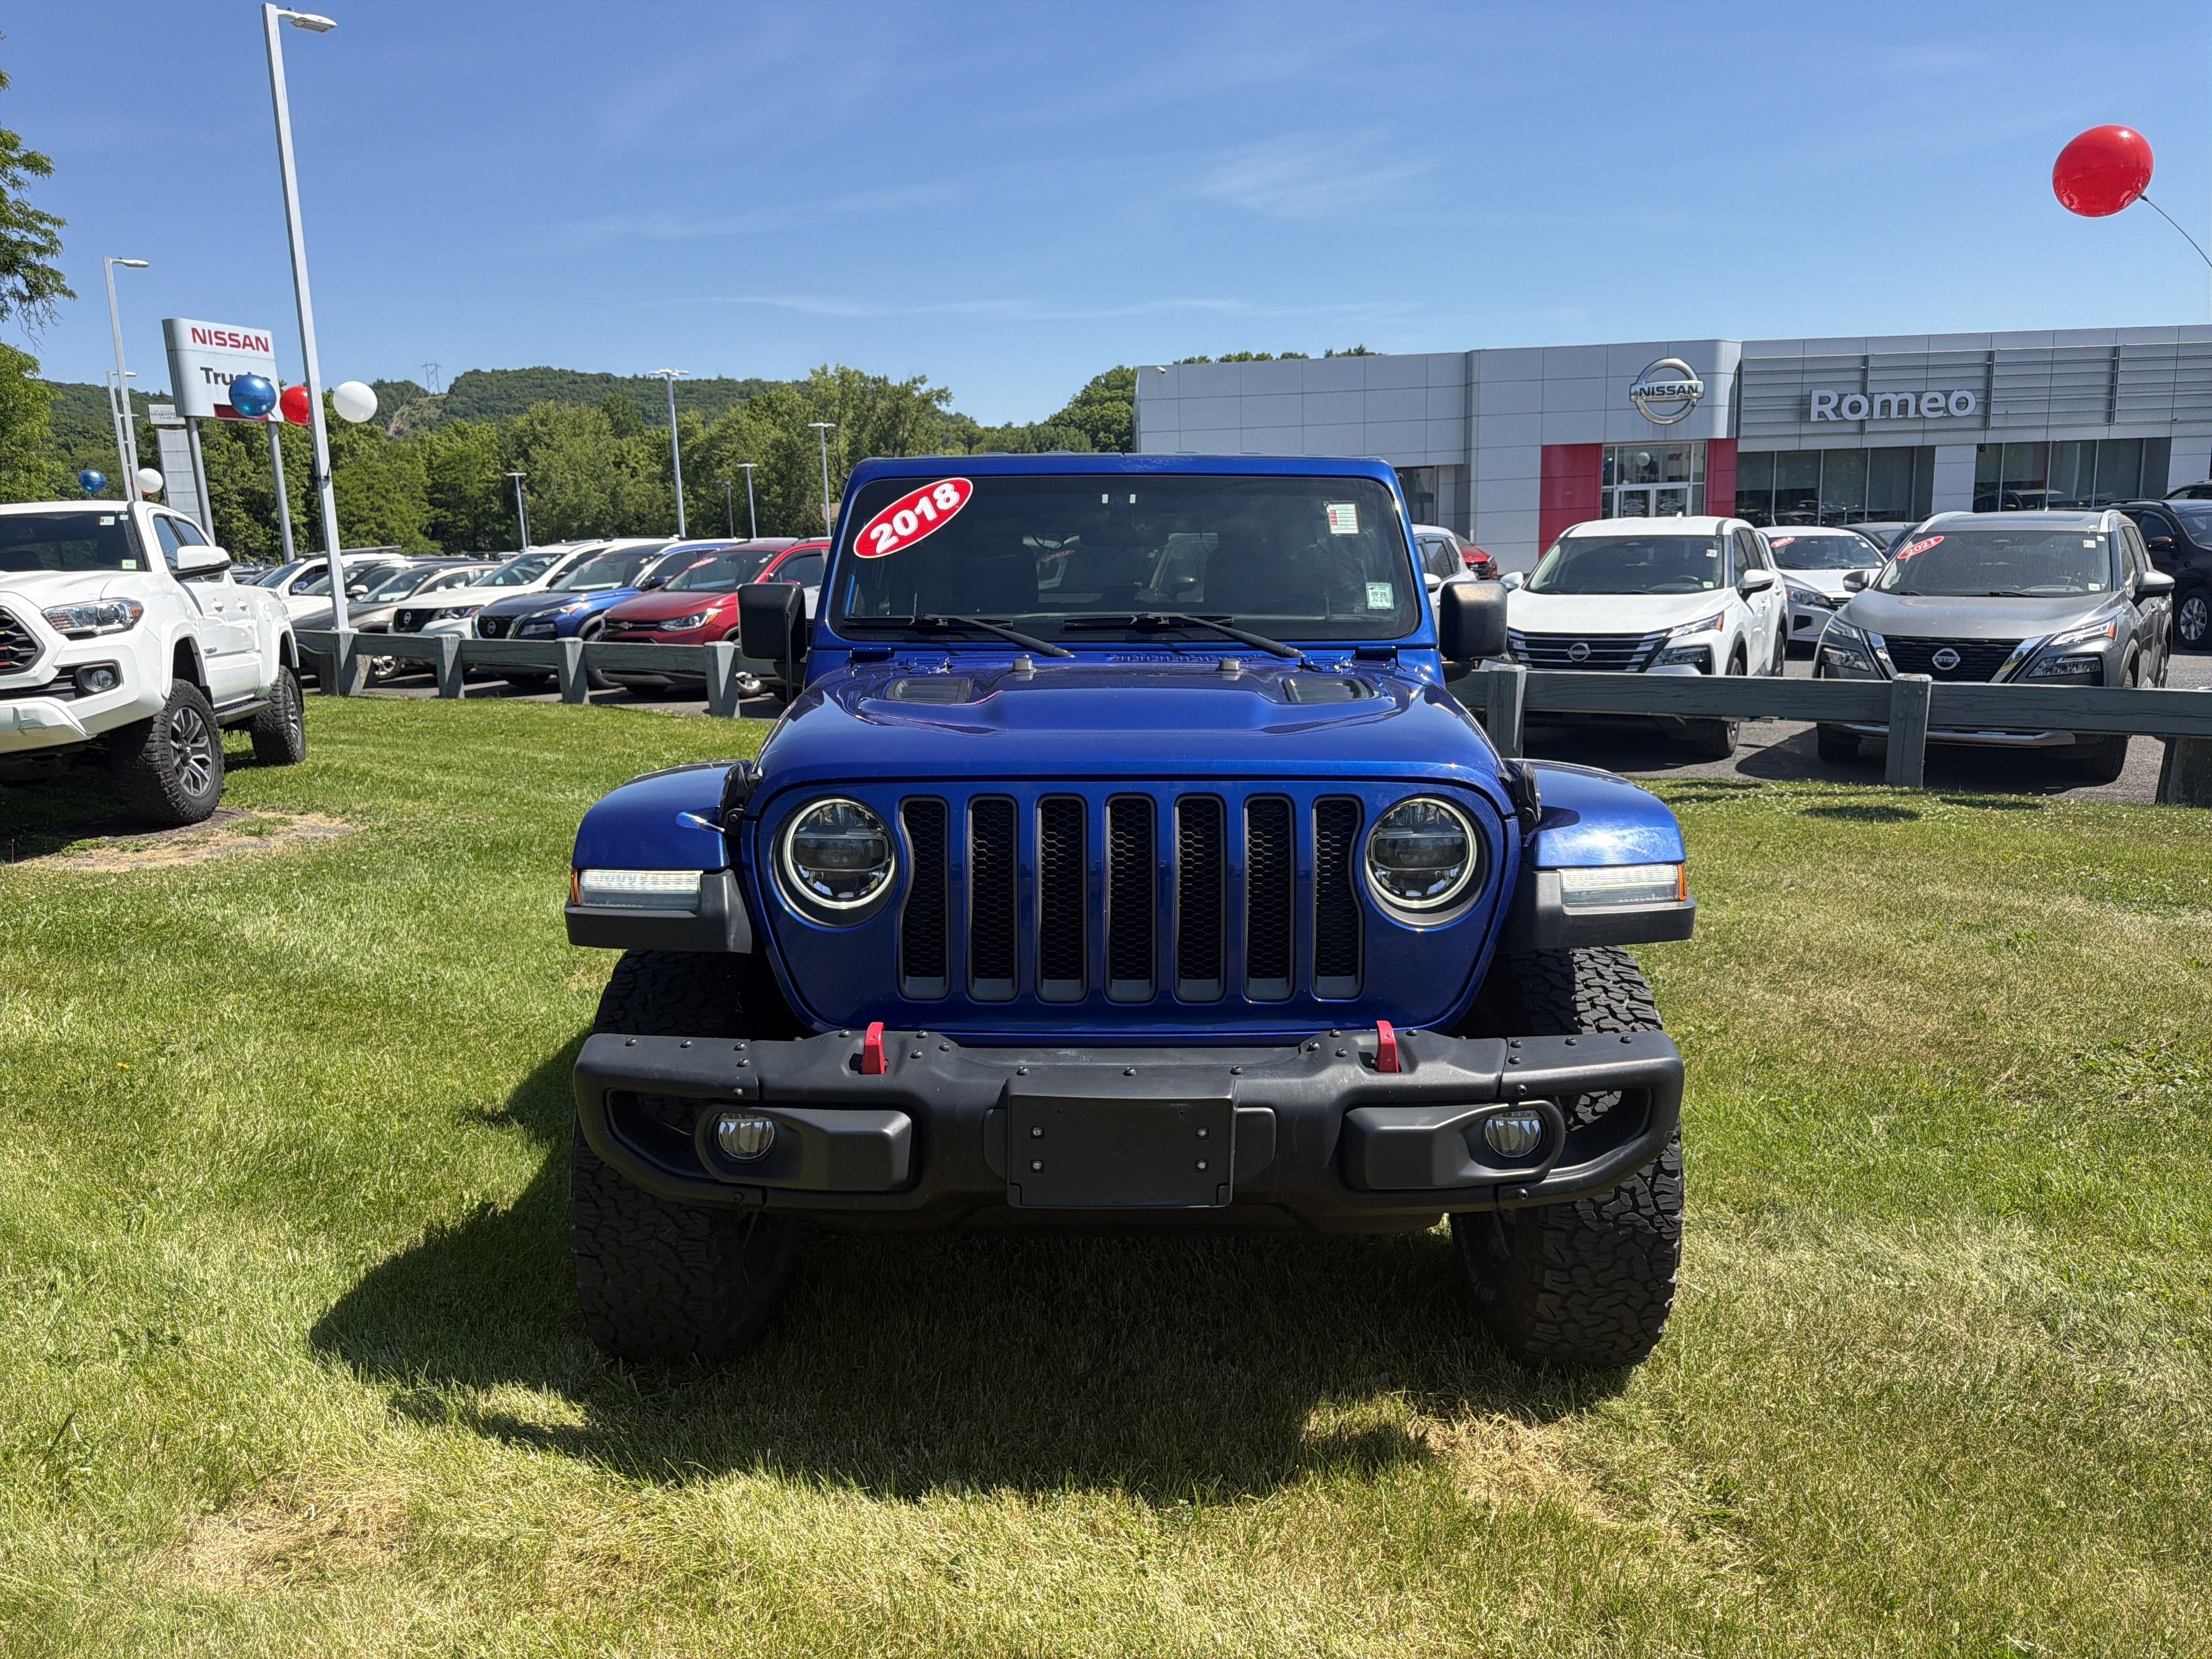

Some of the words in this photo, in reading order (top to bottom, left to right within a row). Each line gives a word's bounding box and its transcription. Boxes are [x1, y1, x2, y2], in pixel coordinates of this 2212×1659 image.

[191, 327, 269, 353] NISSAN
[200, 366, 271, 386] Tru
[1639, 385, 1698, 397] NISSAN
[1810, 390, 1976, 422] Romeo
[870, 483, 960, 554] 2018
[1905, 538, 1937, 557] 2021
